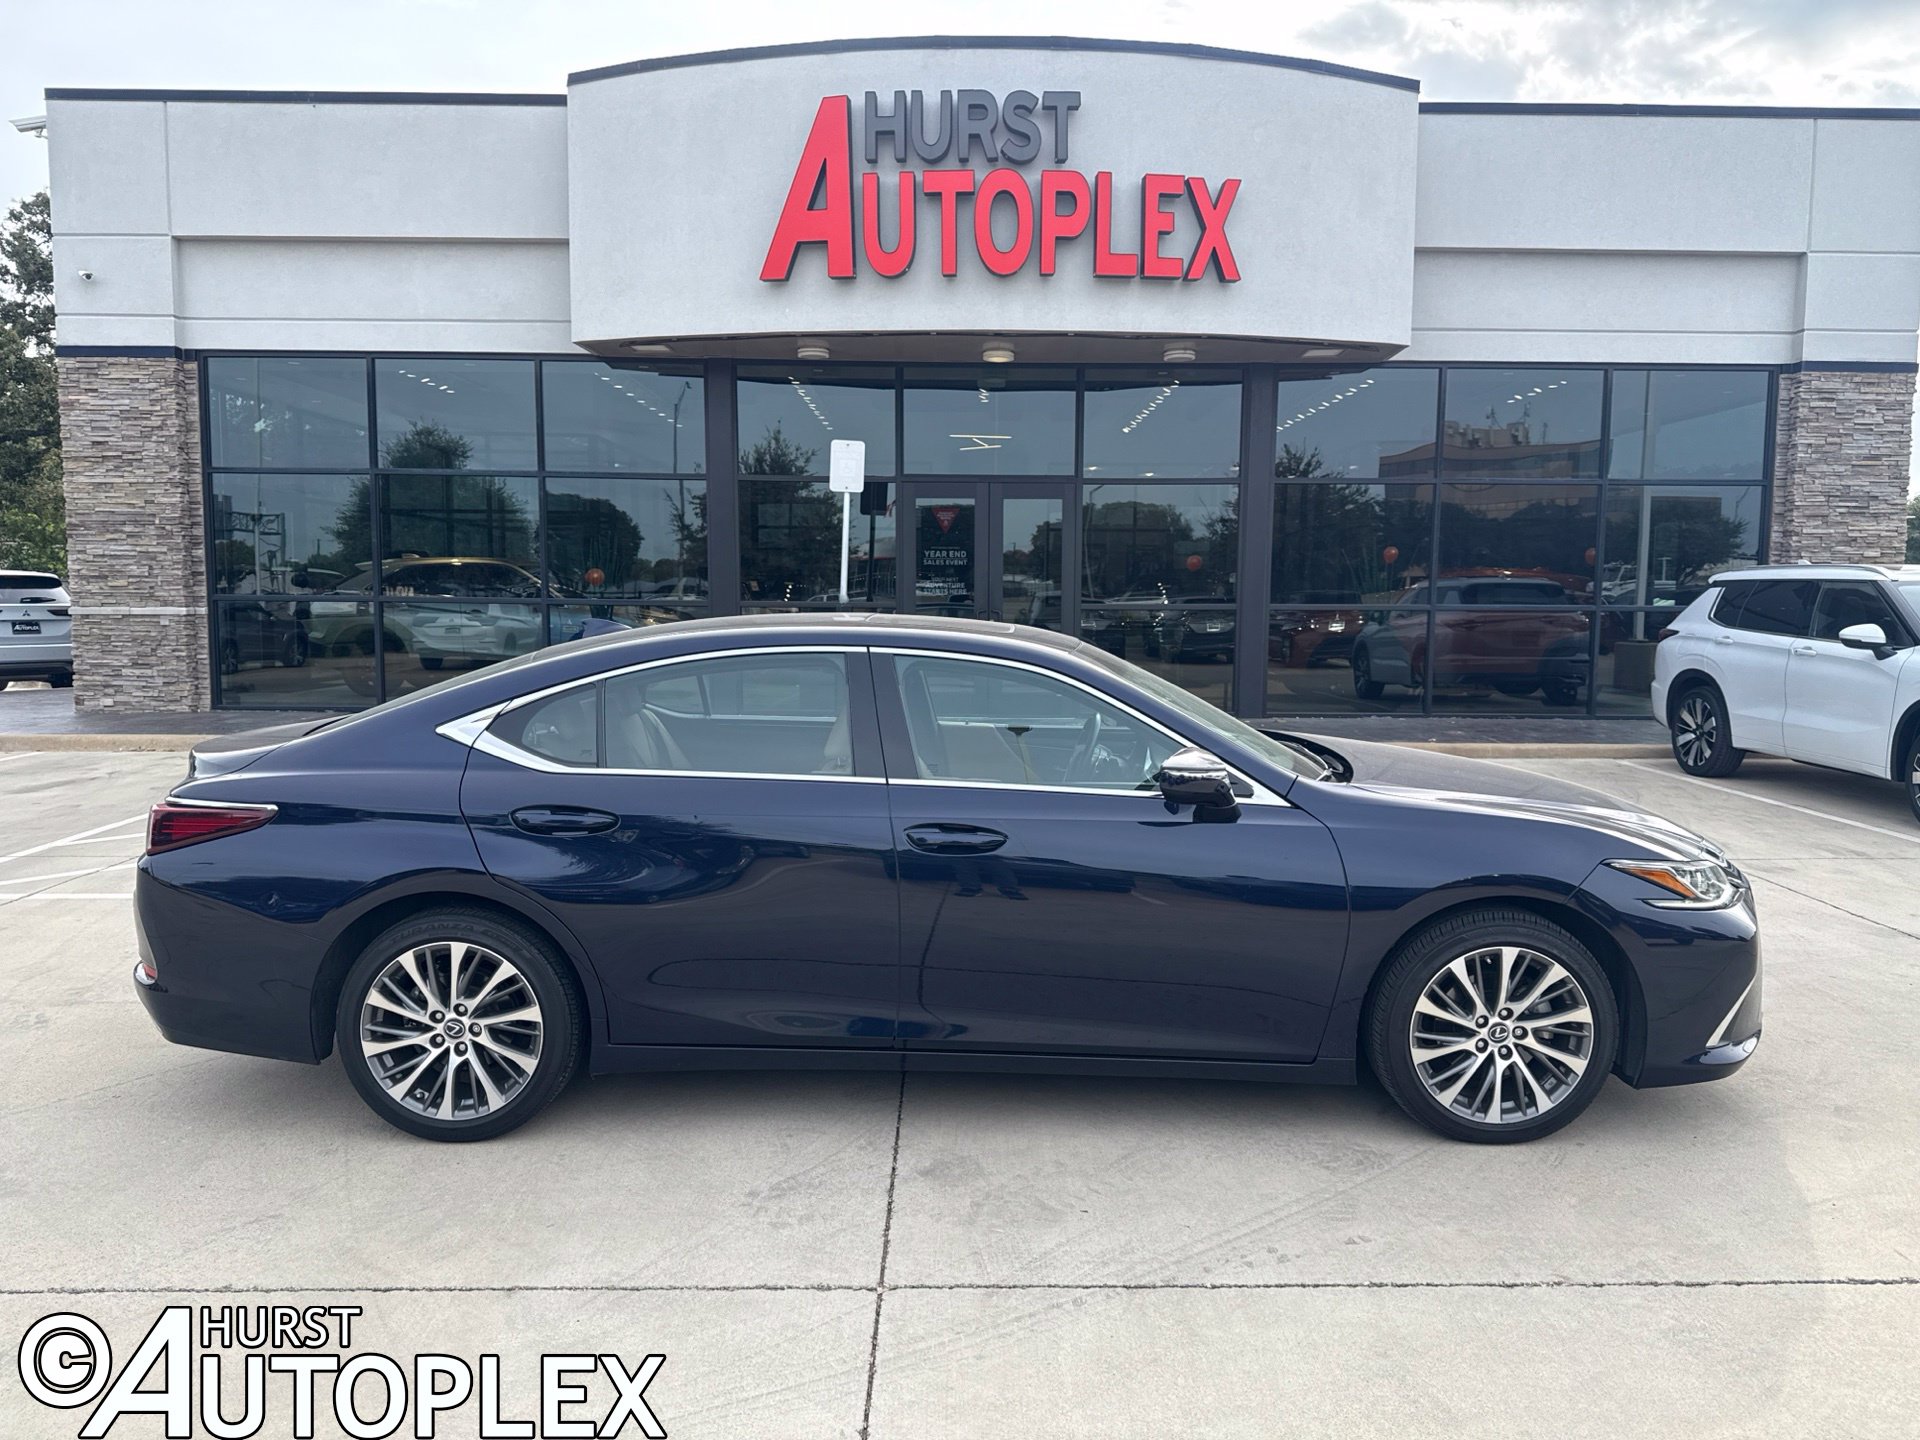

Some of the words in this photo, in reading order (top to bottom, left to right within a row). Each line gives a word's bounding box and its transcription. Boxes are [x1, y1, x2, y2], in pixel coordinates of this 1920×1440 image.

[864, 89, 1082, 165] HURST
[760, 94, 1242, 282] AUTOPLEX
[924, 550, 947, 558] YEAR
[949, 550, 967, 558] END
